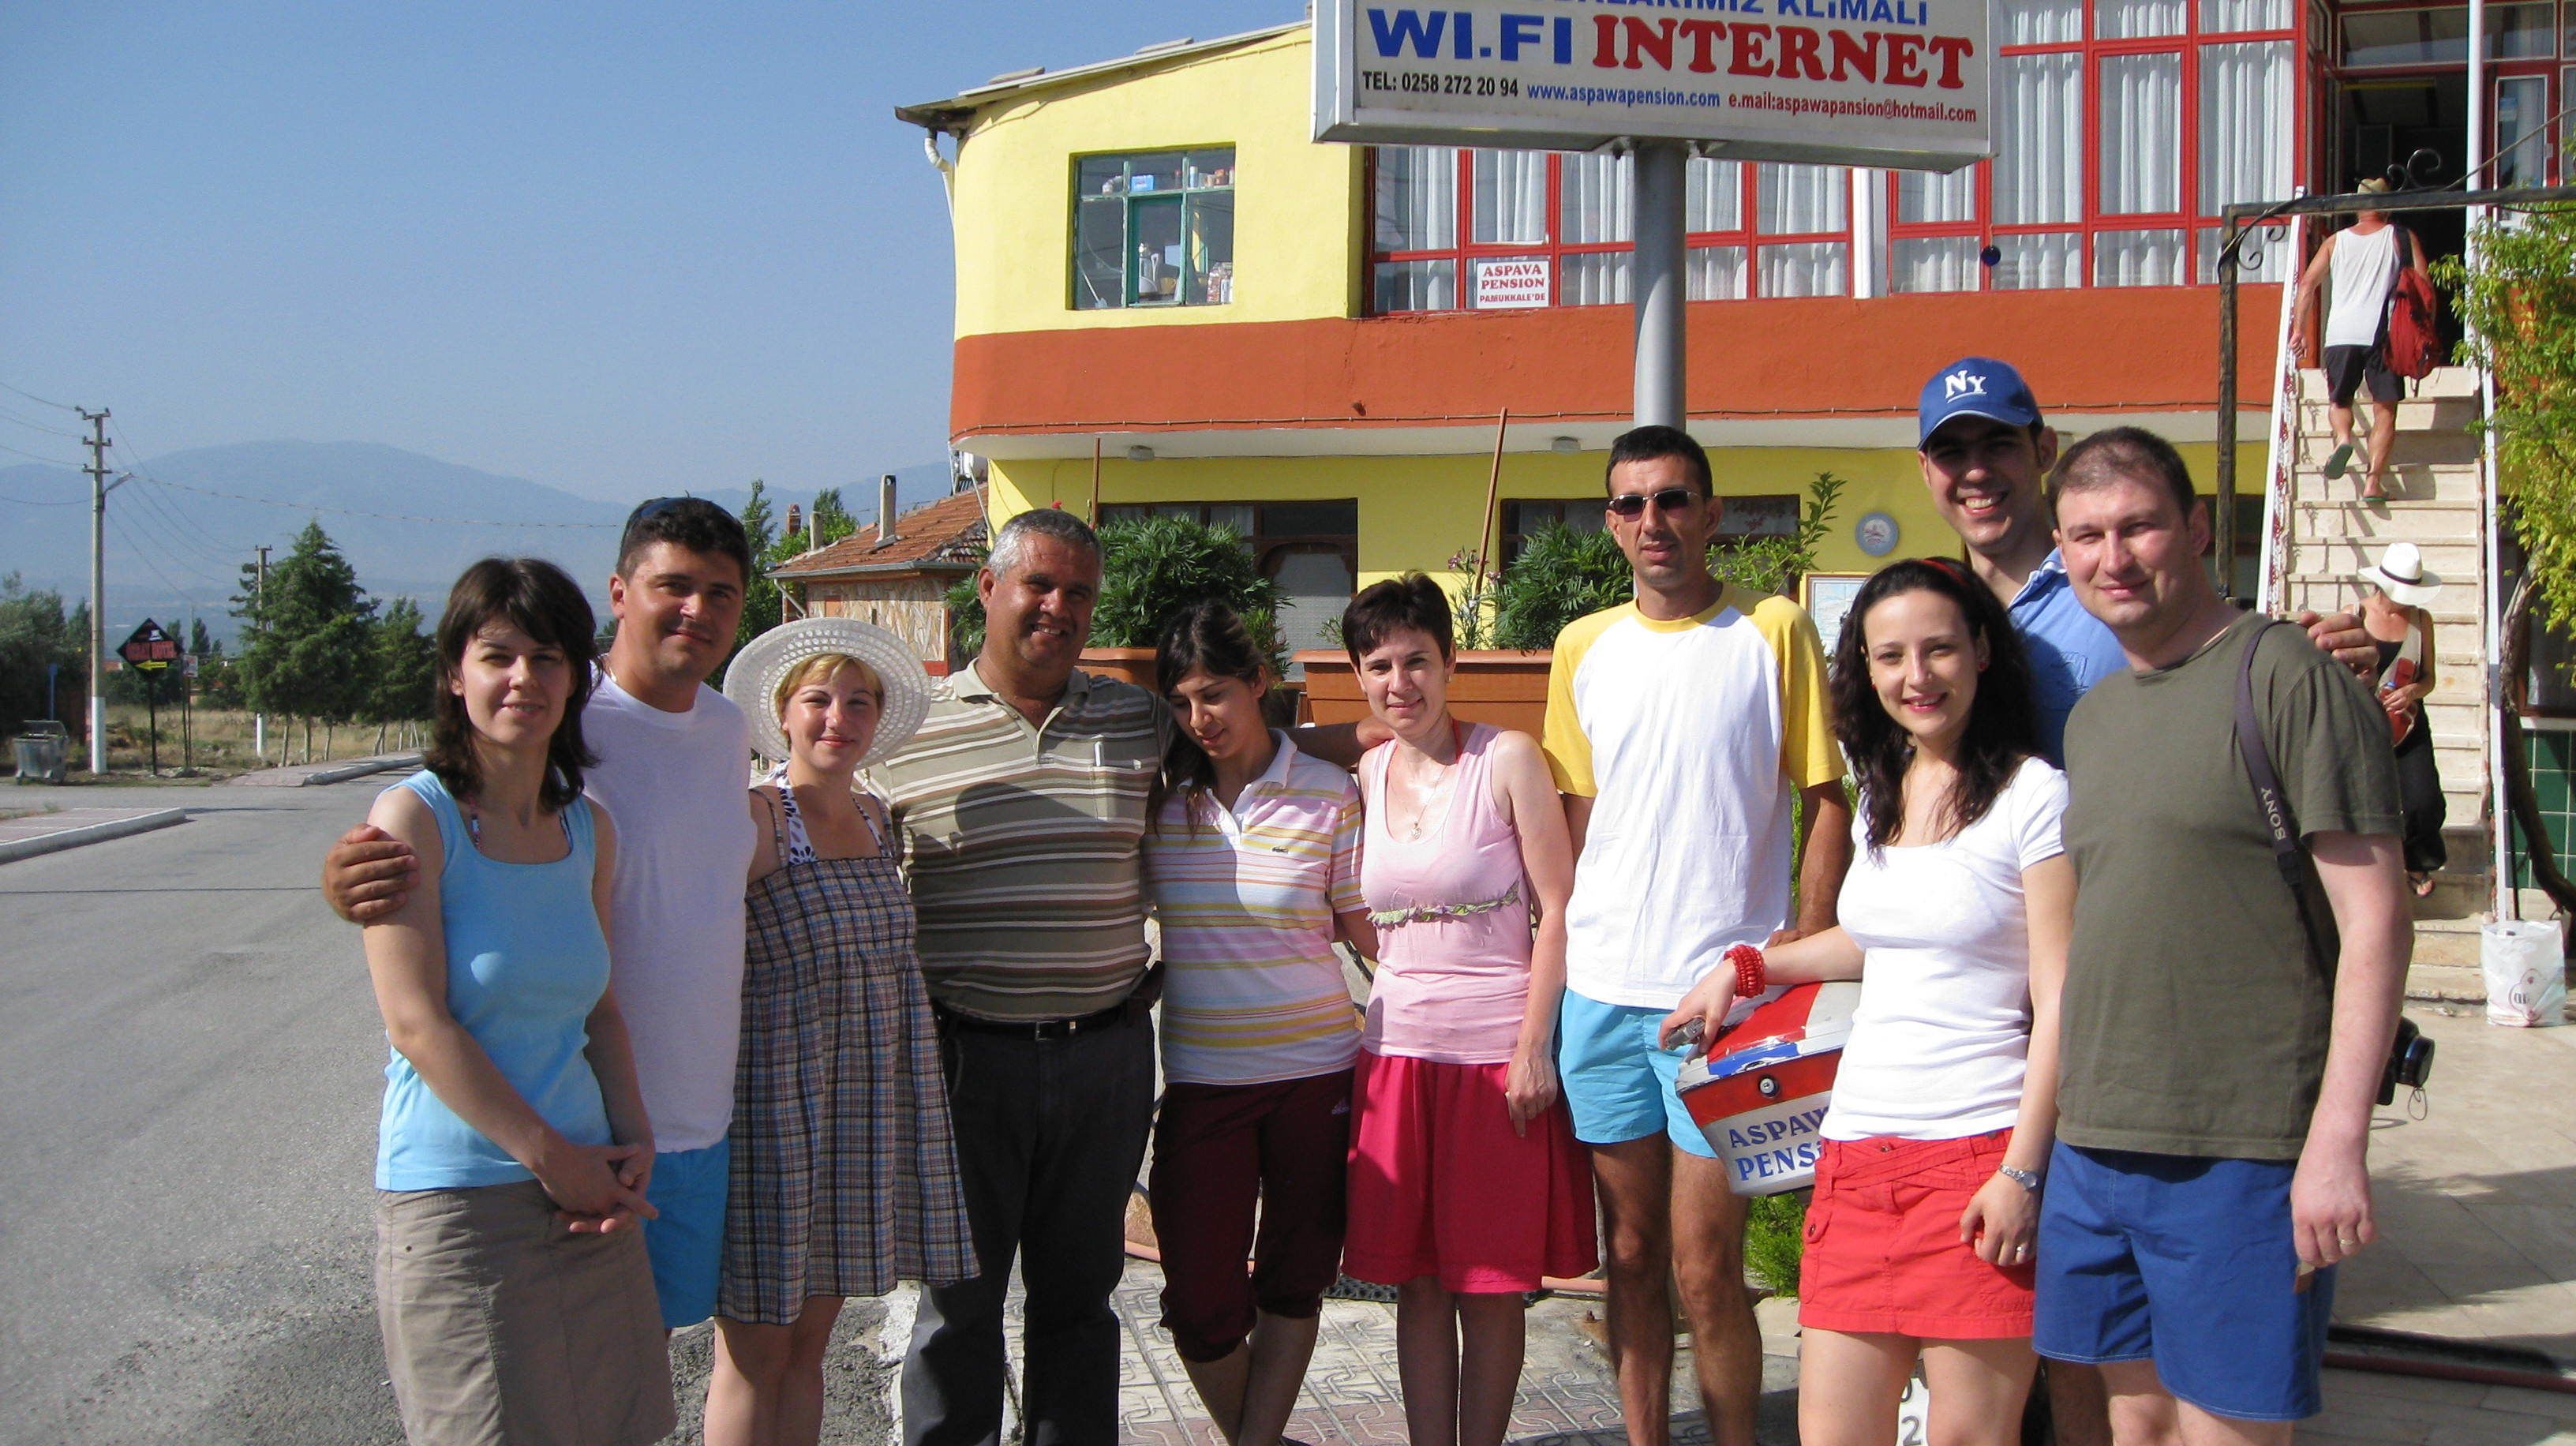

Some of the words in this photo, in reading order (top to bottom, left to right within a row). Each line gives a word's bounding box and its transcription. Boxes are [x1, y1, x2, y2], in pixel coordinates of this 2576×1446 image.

[1367, 8, 1572, 65] WI.FI
[1593, 14, 1974, 89] INTERNET
[1362, 70, 1397, 92] TEL:
[1402, 73, 1439, 93] 0258
[1443, 74, 1472, 95] 272
[1476, 76, 1496, 96] 20
[1500, 77, 1518, 97] 94
[1527, 83, 1720, 108] www.aspawapension.com
[1728, 91, 1977, 122] e.mail:aspawapansion@hotmail.com
[1481, 277, 1545, 290] PENSION
[1483, 264, 1542, 277] ASPAVA
[1479, 293, 1546, 303] PAMUKKALE'DE
[1945, 369, 1986, 399] NY
[2260, 787, 2286, 841] SONY
